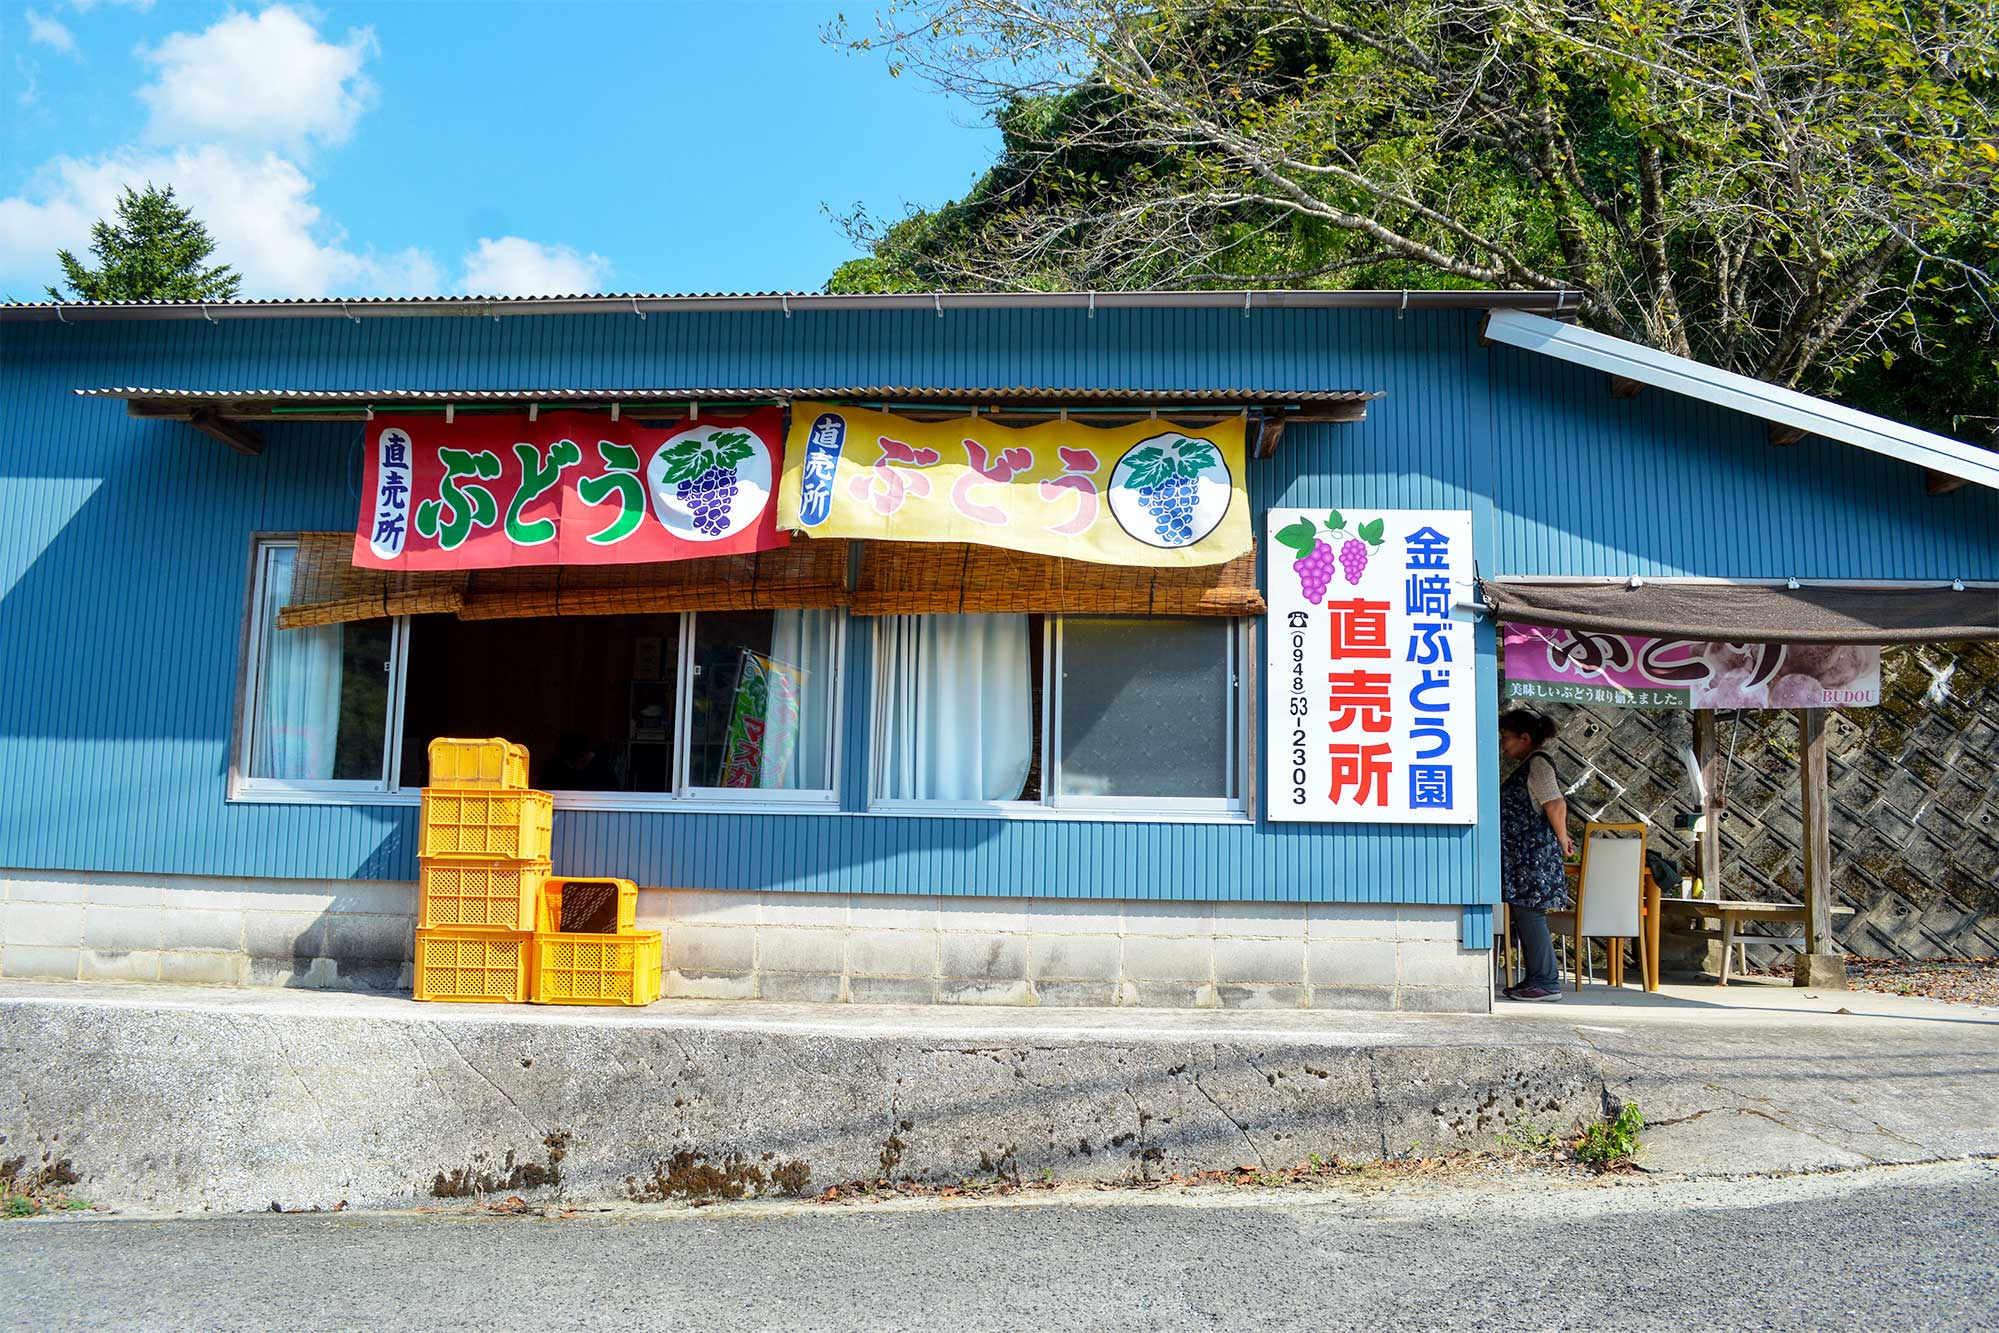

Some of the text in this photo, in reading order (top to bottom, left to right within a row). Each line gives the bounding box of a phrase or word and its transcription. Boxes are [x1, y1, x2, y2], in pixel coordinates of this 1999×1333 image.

[373, 433, 409, 551] 直売所
[416, 438, 646, 551] ぶどう
[800, 417, 841, 518] 直売所
[849, 436, 1100, 536] ぶどう
[1328, 597, 1393, 807] 直売所
[1510, 682, 1684, 706] 美味しいぶどう取り揃えました。
[1822, 689, 1876, 703] BUDOU
